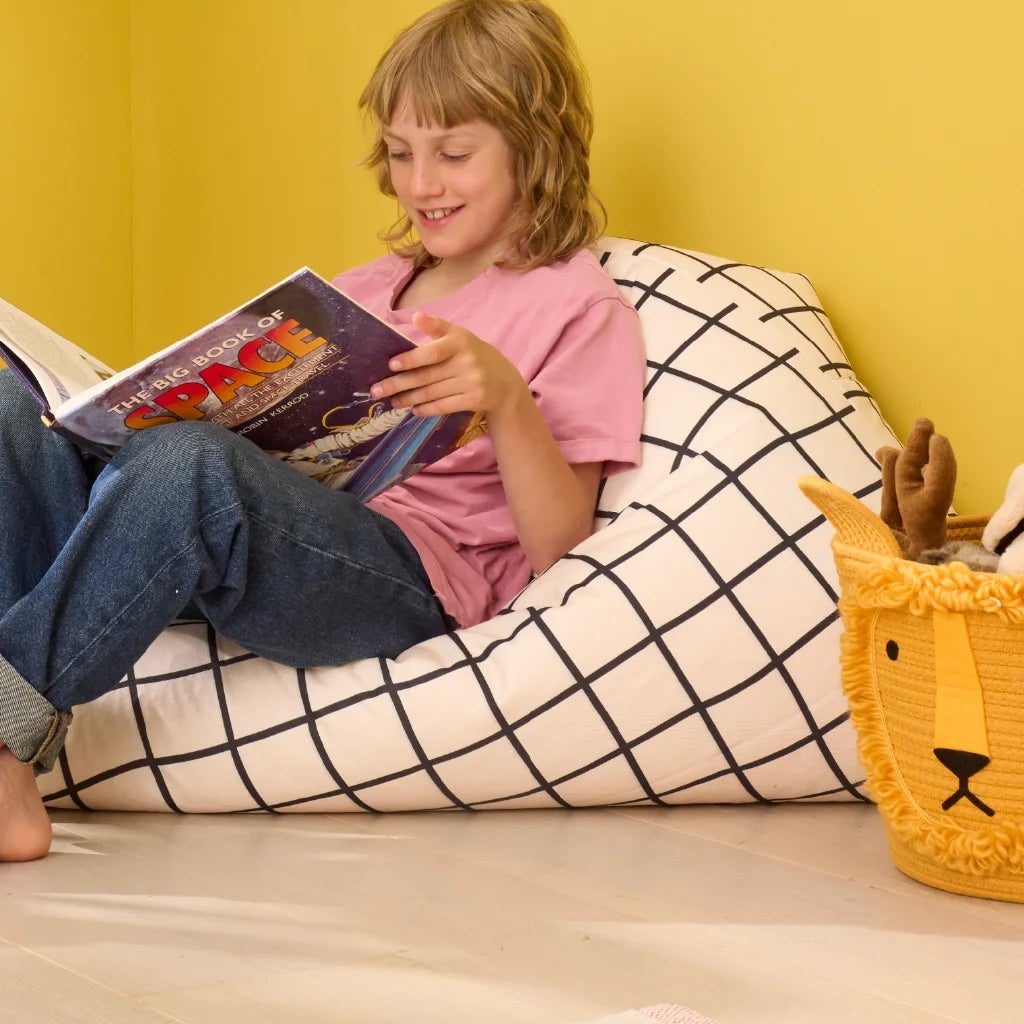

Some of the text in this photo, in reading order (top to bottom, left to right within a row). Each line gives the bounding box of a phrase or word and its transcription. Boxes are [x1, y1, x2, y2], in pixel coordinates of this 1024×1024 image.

[106, 309, 285, 415] THE BIG BOOK OF
[123, 318, 328, 430] SPACE
[234, 396, 254, 410] ALL
[253, 382, 274, 399] THE
[274, 344, 339, 385] EXCITEMENT
[235, 362, 331, 420] AND SPACE TRAVEL
[269, 392, 309, 417] KERROD
